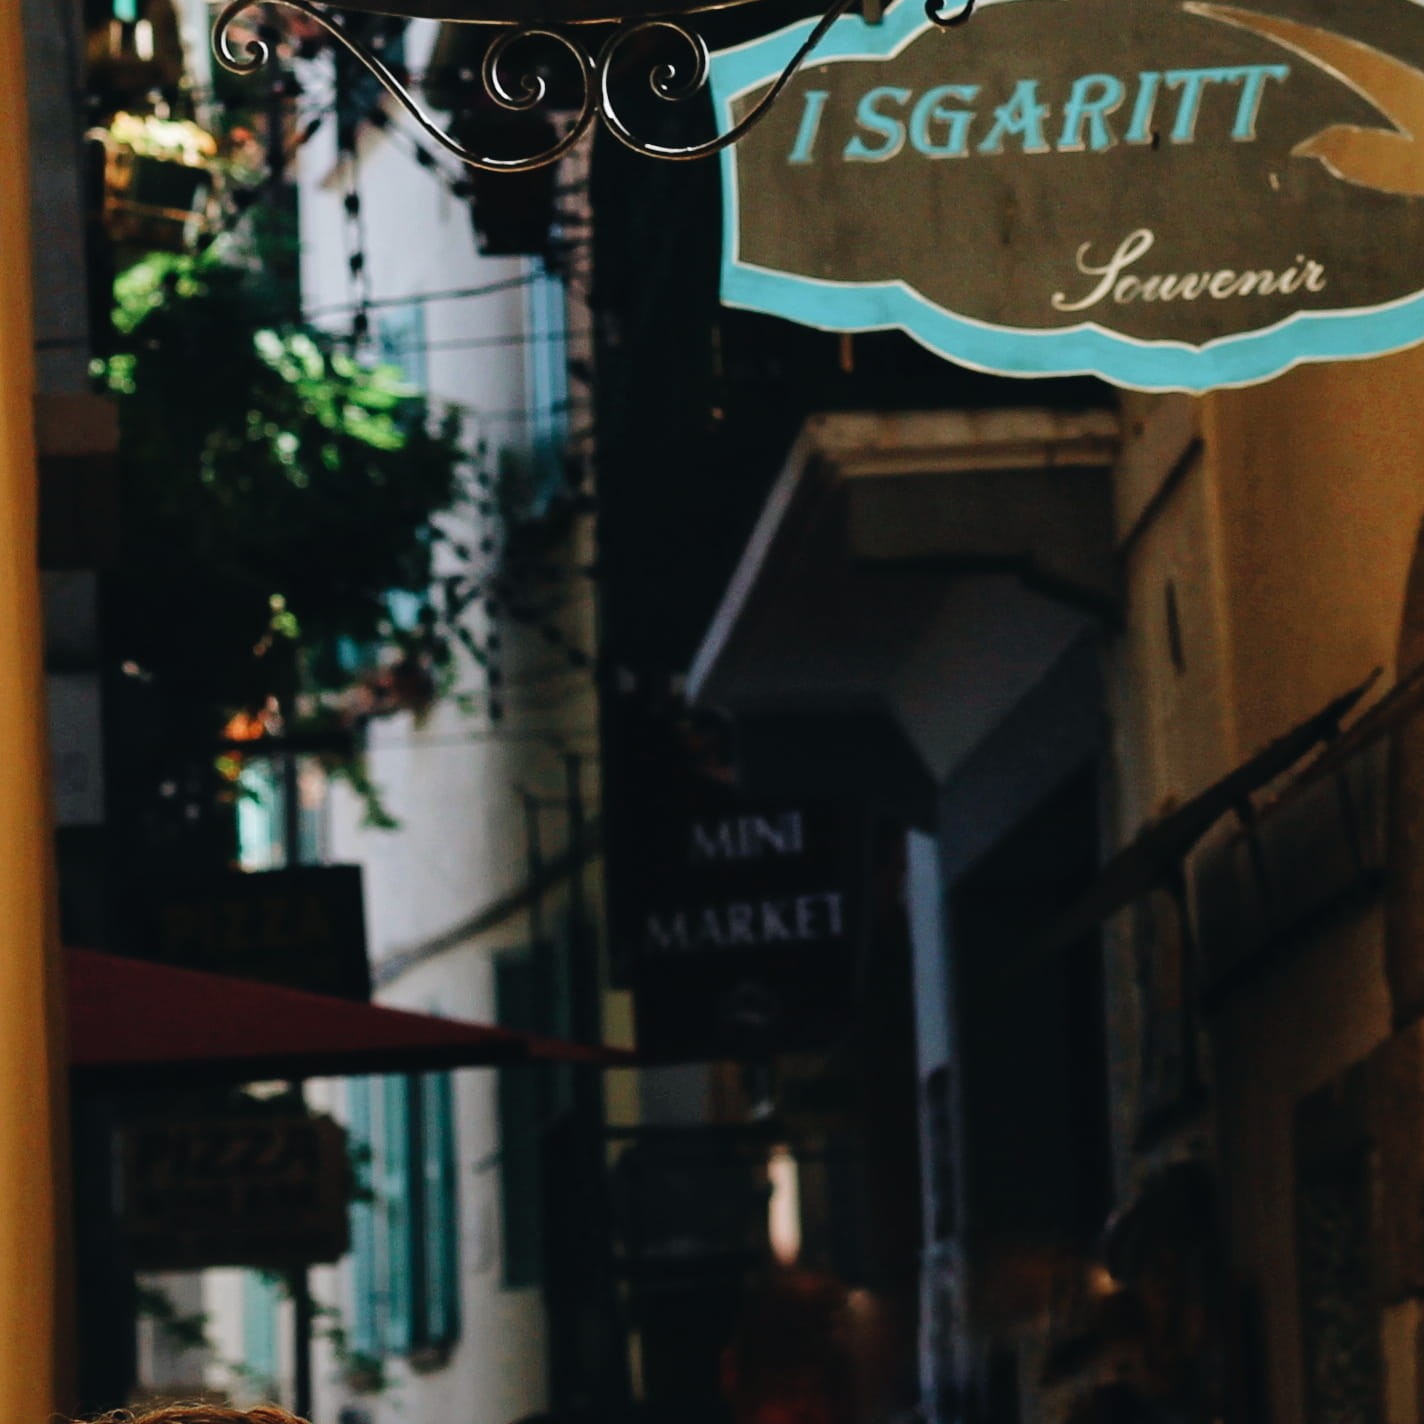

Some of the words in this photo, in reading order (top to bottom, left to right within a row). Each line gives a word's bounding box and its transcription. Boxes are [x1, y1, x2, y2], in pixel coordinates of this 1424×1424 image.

[788, 91, 828, 164] I
[843, 64, 1290, 162] SGARITT
[1051, 228, 1327, 311] Souvenir
[686, 809, 805, 863] MINI
[645, 890, 847, 954] MARKET
